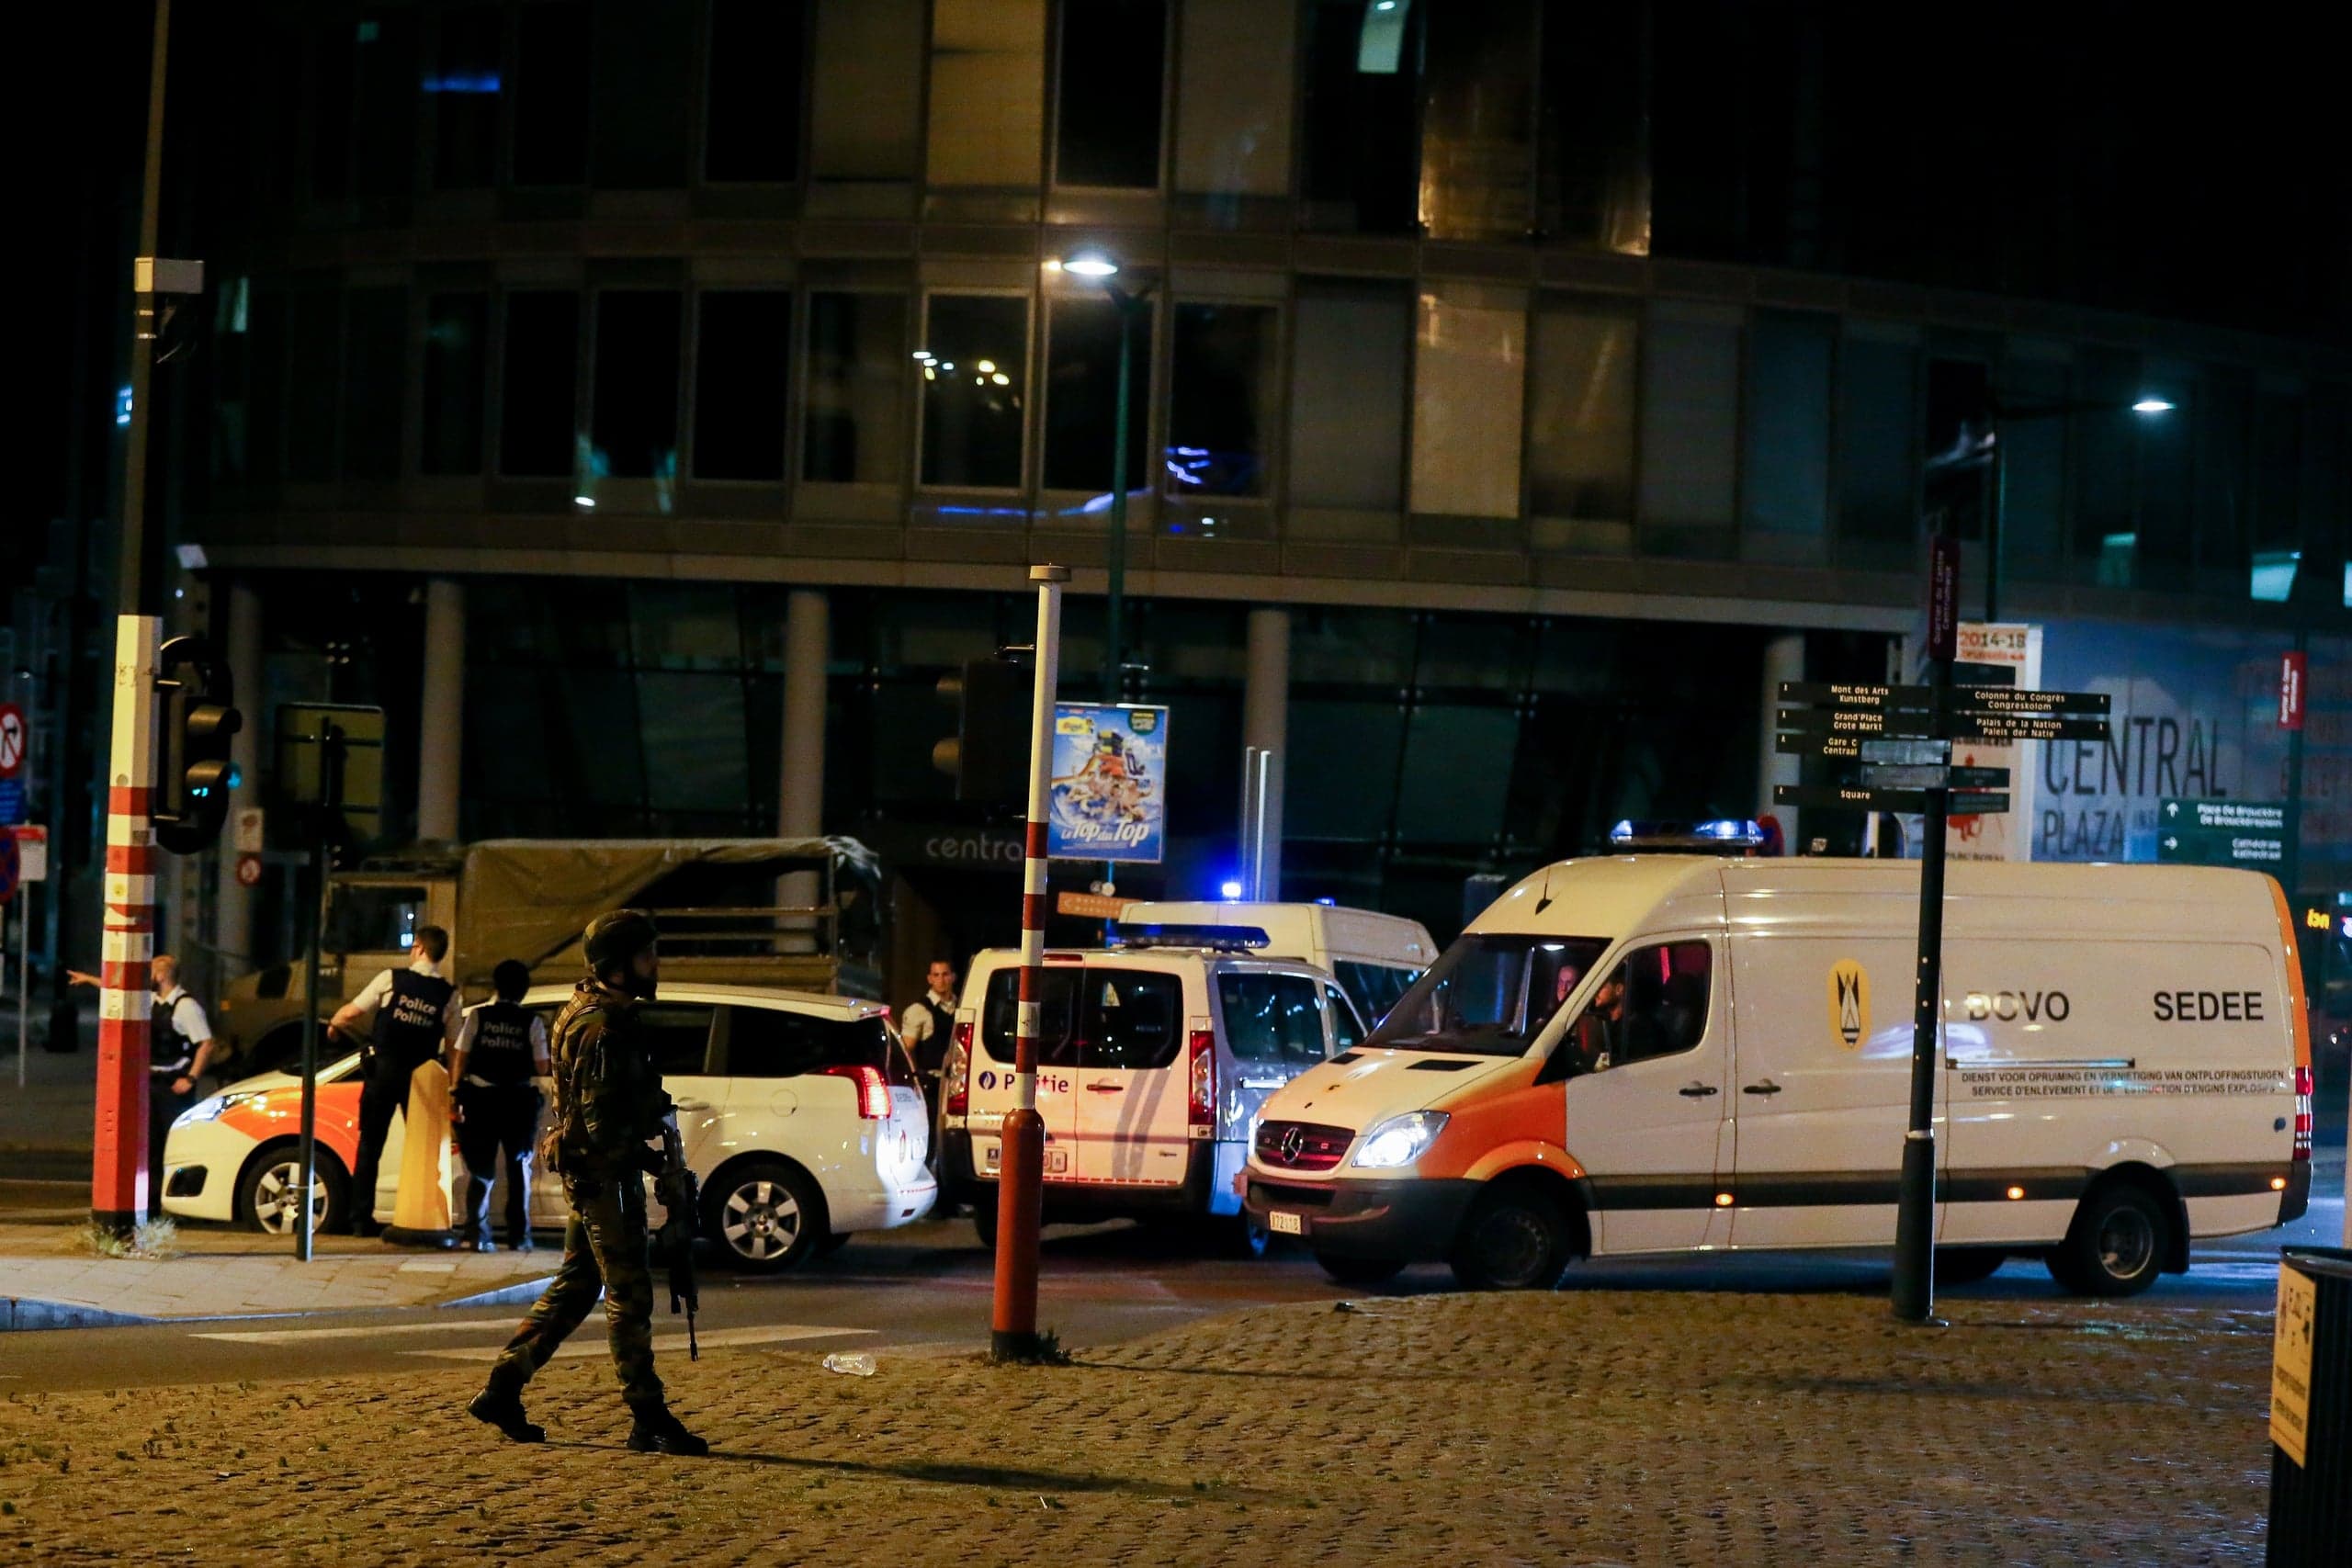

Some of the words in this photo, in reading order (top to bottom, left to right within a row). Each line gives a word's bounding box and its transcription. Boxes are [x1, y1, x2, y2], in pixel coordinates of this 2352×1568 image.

[1831, 684, 1851, 694] Mont
[1854, 686, 1869, 694] des
[1872, 686, 1889, 695] Arts
[1839, 695, 1881, 705] Kunstberg
[1974, 691, 2009, 700] Colonne
[2014, 693, 2026, 701] du
[1987, 701, 2052, 710] Congreskolom
[1834, 712, 1883, 722] Grand'Place
[1833, 722, 1856, 730] Grote
[1859, 722, 1883, 731] Markt
[1976, 718, 2001, 727] Palais
[2006, 719, 2017, 728] de
[2021, 719, 2029, 728] la
[2032, 720, 2063, 729] Nation
[1983, 727, 2007, 736] Paleis
[2013, 728, 2027, 737] der
[1828, 737, 1848, 747] Gare
[1823, 745, 1858, 756] Centraal
[2044, 716, 2227, 797] CENTRAL
[1840, 790, 1871, 799] Square
[1071, 819, 1101, 843] Top
[1114, 818, 1150, 847] Top
[2041, 809, 2126, 857] PLAZA
[925, 833, 1025, 862] centra
[398, 994, 437, 1015] Police
[2154, 991, 2264, 1021] SEDEE
[483, 1021, 523, 1035] Police
[481, 1034, 524, 1050] Politie
[1962, 1072, 1996, 1082] DIENST
[1998, 1072, 2025, 1082] VOOR
[2028, 1072, 2081, 1081] OPRUIMING
[2084, 1072, 2097, 1081] EN
[2164, 1071, 2183, 1080] VAN
[2185, 1070, 2284, 1080] ONTPLOFFINGSTUIGEN
[1004, 1073, 1069, 1093] Pitie
[1972, 1086, 2012, 1096] SERVICE
[2015, 1086, 2086, 1096] D'ENLEVEMENT
[2088, 1085, 2099, 1095] ET
[2121, 1084, 2182, 1094] ESTRUCTION
